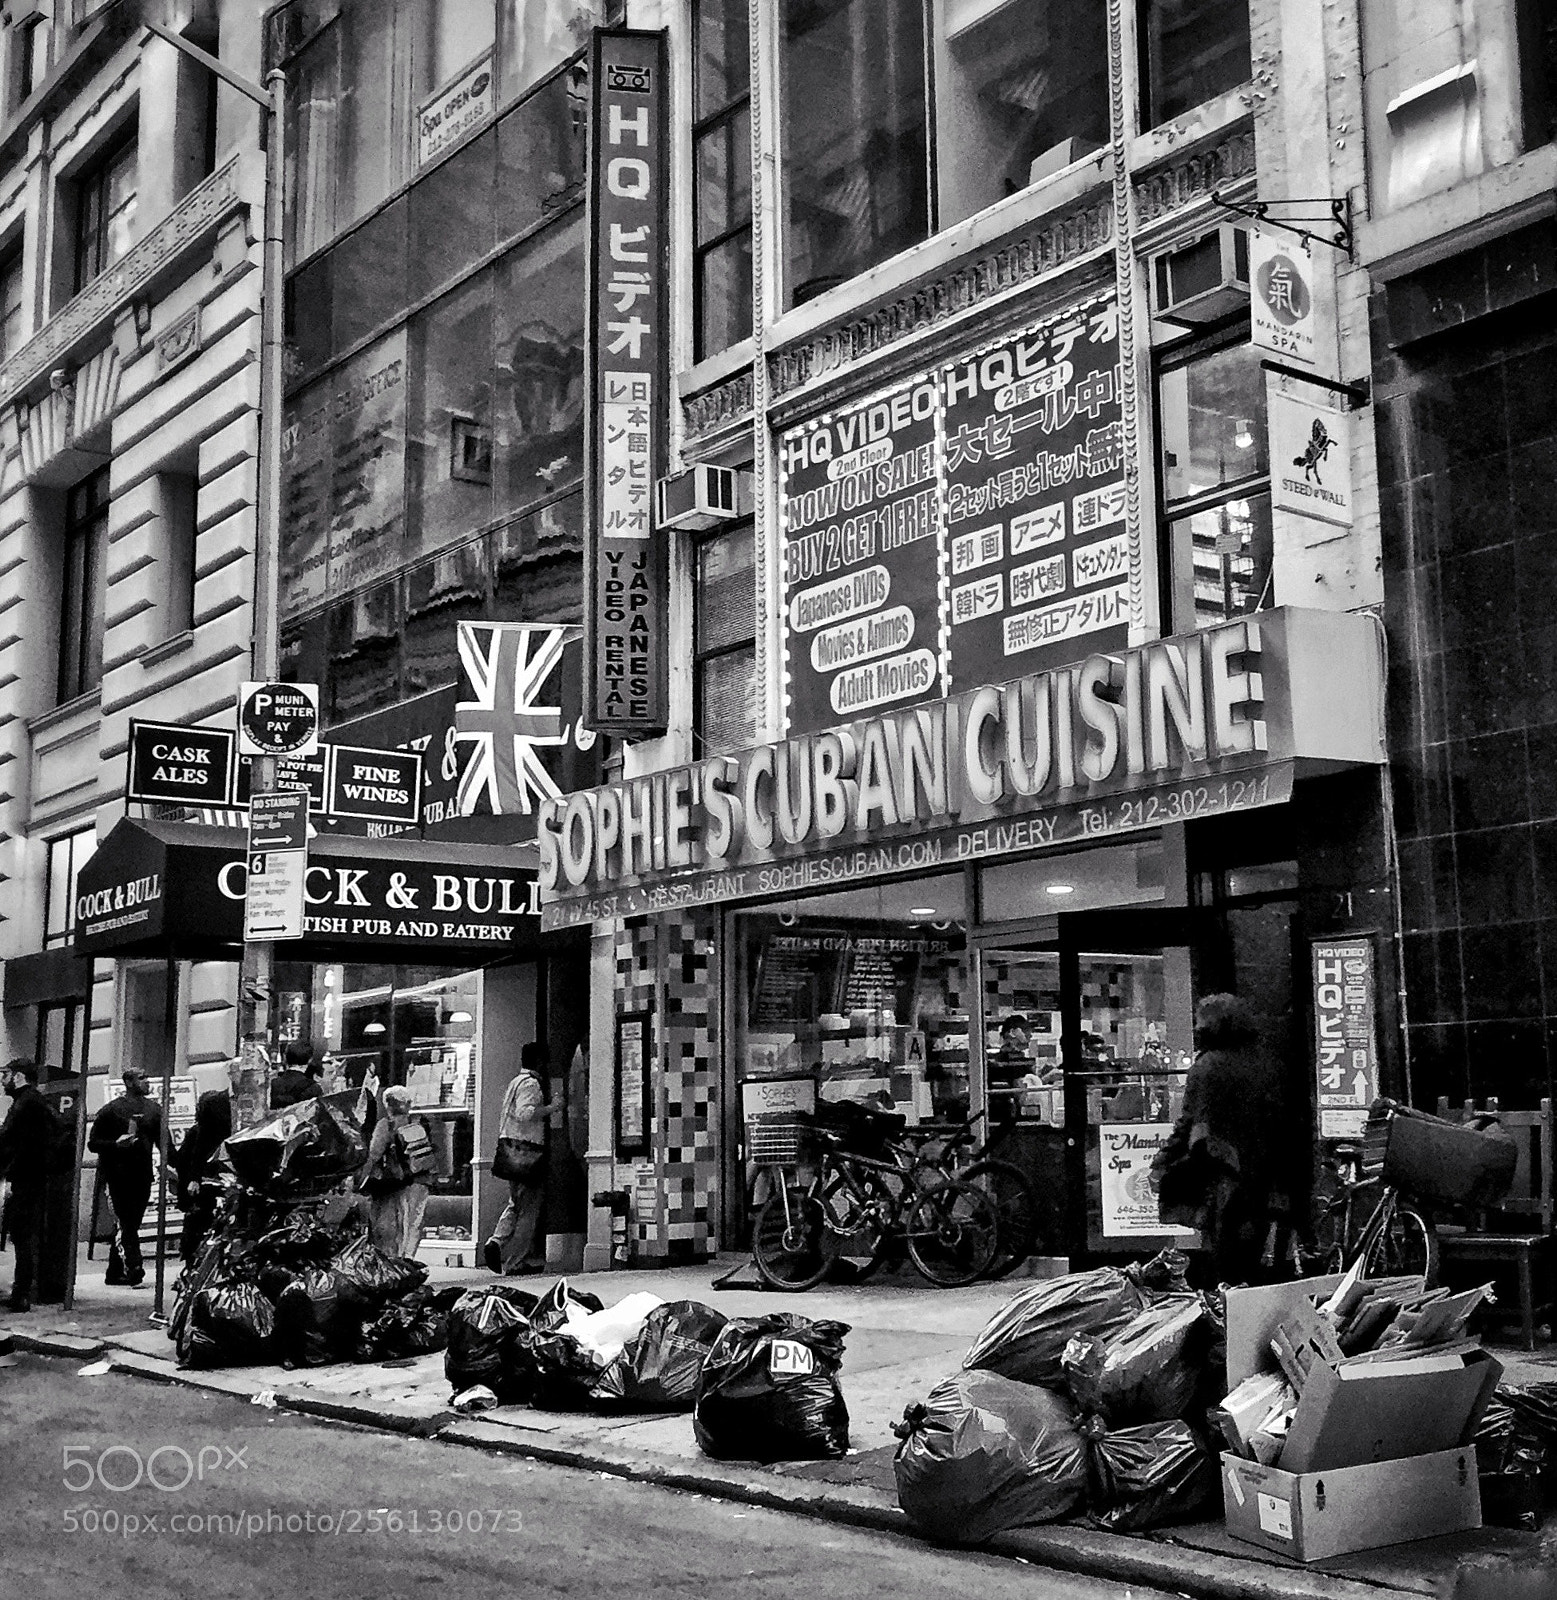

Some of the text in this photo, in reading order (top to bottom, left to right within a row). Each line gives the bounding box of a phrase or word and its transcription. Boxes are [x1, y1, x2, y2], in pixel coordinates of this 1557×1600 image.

[1257, 319, 1313, 344] MANDARIN
[1271, 335, 1298, 353] SPA
[788, 383, 936, 475] HQ VIDEO
[606, 380, 628, 529] レンタル
[627, 382, 648, 530] 日本語ビデオ
[836, 448, 887, 477] 2nd Floor
[787, 480, 840, 532] NOW
[841, 466, 873, 511] ON
[1282, 478, 1313, 497] STEED
[1319, 488, 1347, 507] WALL
[1077, 487, 1127, 530] 連ドラ
[786, 487, 939, 586] BUY 2 GET 1 FREE
[1014, 509, 1063, 550] アニメ
[1012, 557, 1064, 601] 時代劇
[796, 569, 886, 628] Japanese DVDs
[955, 581, 1000, 620] 韓ドラ
[1007, 589, 1129, 650] 無修正アダルト
[604, 551, 626, 718] VIDEO RENTAL
[629, 551, 649, 718] JAPANESE
[817, 613, 909, 668] Movies & Animes
[838, 656, 929, 710] Adult Movies
[254, 693, 304, 716] P MUNI
[274, 706, 315, 718] METER
[266, 721, 291, 732] PAY
[274, 733, 283, 744] &
[152, 744, 211, 765] CASK
[286, 762, 307, 771] POT
[538, 622, 1268, 891] SOPHIE'S CUBAN CUISINE
[152, 766, 209, 785] ALES
[352, 764, 401, 784] FINE
[342, 783, 410, 805] WINES
[423, 802, 444, 825] UB
[758, 840, 942, 891] SOPHIESCUBAN.COM
[957, 815, 1058, 859] DELIVERY
[1078, 808, 1114, 836] Tel:
[1119, 775, 1270, 828] 212-302-1211
[252, 854, 263, 874] 6
[77, 873, 161, 920] COCK & BULL
[217, 861, 371, 908] CCK
[386, 872, 419, 909] &
[304, 916, 515, 941] TISH PUB AND EATERY
[1317, 947, 1366, 958] HQ VIDEO
[908, 1037, 923, 1061] A
[59, 1096, 74, 1114] P
[1327, 1096, 1360, 1104] 2ND FL
[1104, 1133, 1119, 1141] The
[1108, 1155, 1132, 1174] Spa
[773, 1344, 812, 1370] PM
